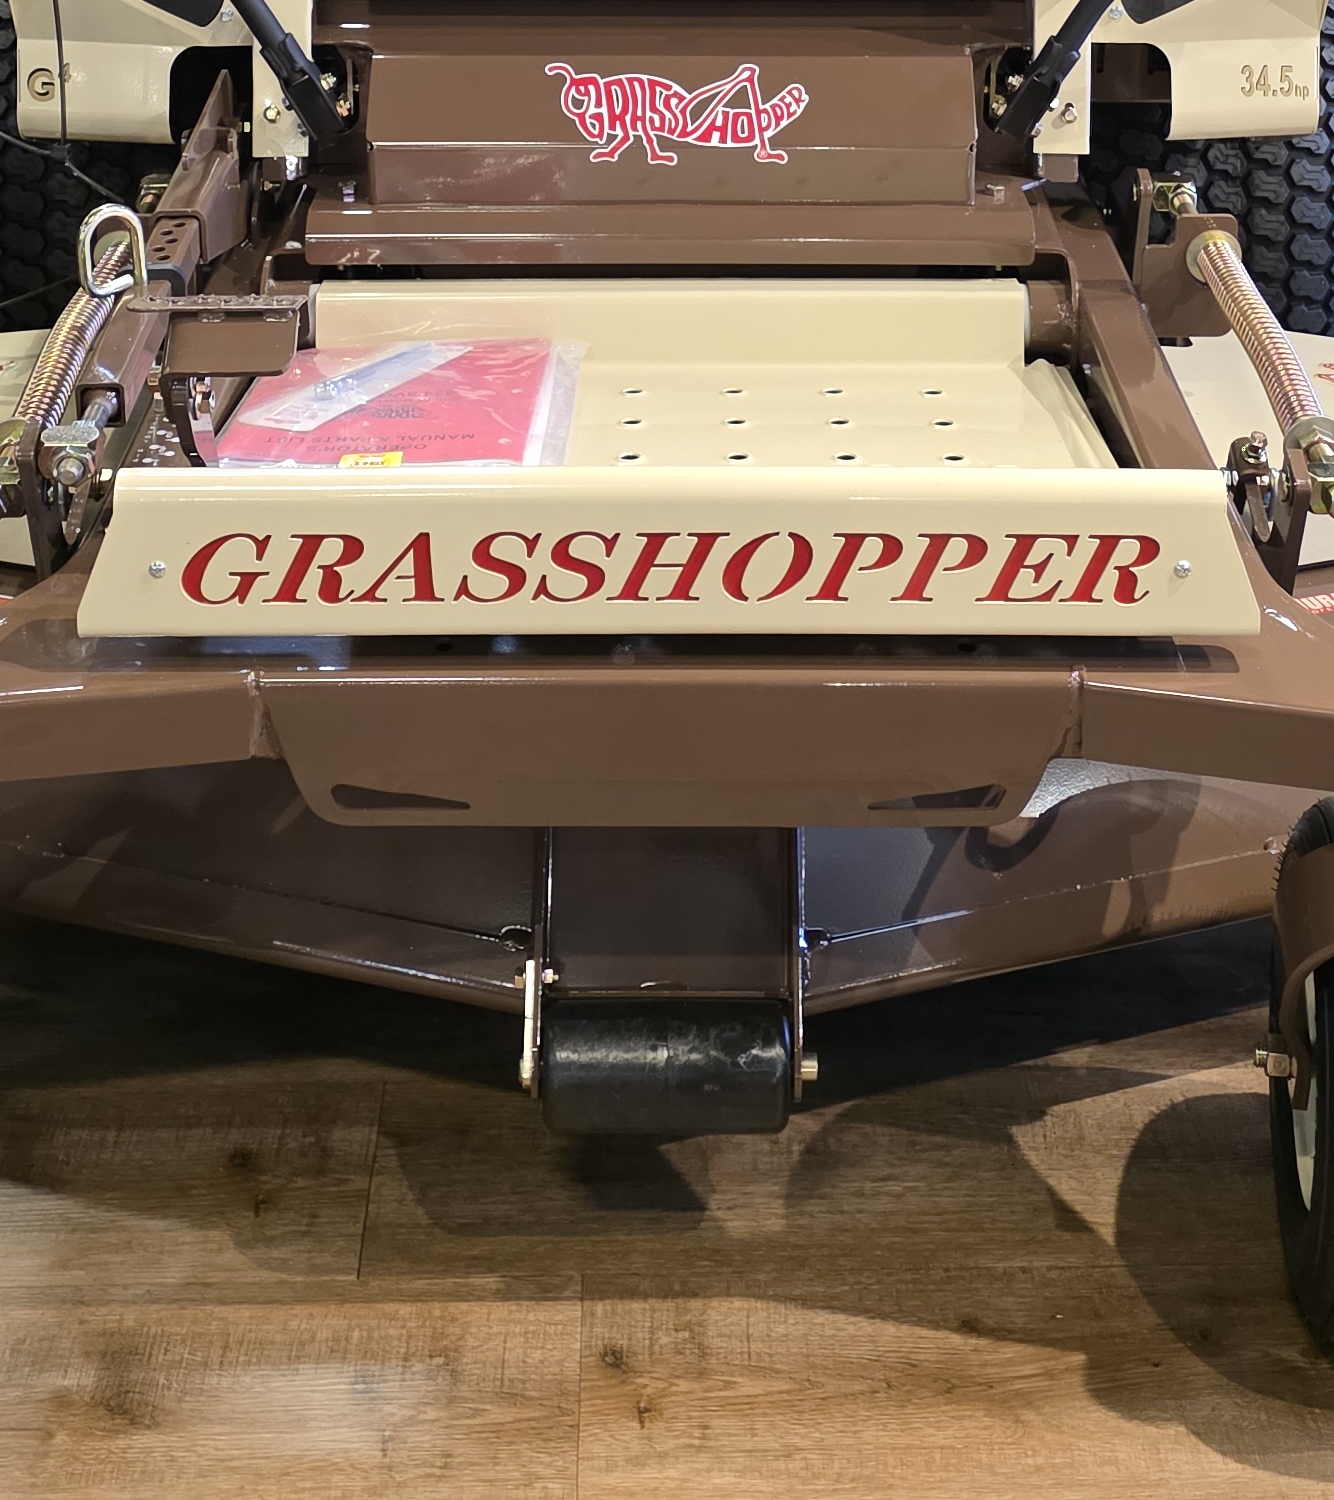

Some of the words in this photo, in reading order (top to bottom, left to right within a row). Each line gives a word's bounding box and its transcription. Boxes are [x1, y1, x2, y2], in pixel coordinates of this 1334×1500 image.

[562, 73, 808, 146] GRASSHOPPER
[311, 435, 374, 444] PARTS
[395, 433, 475, 443] MANUAL
[304, 443, 428, 453] OPERATOR'S
[181, 531, 1161, 605] GRASSHOPPER
